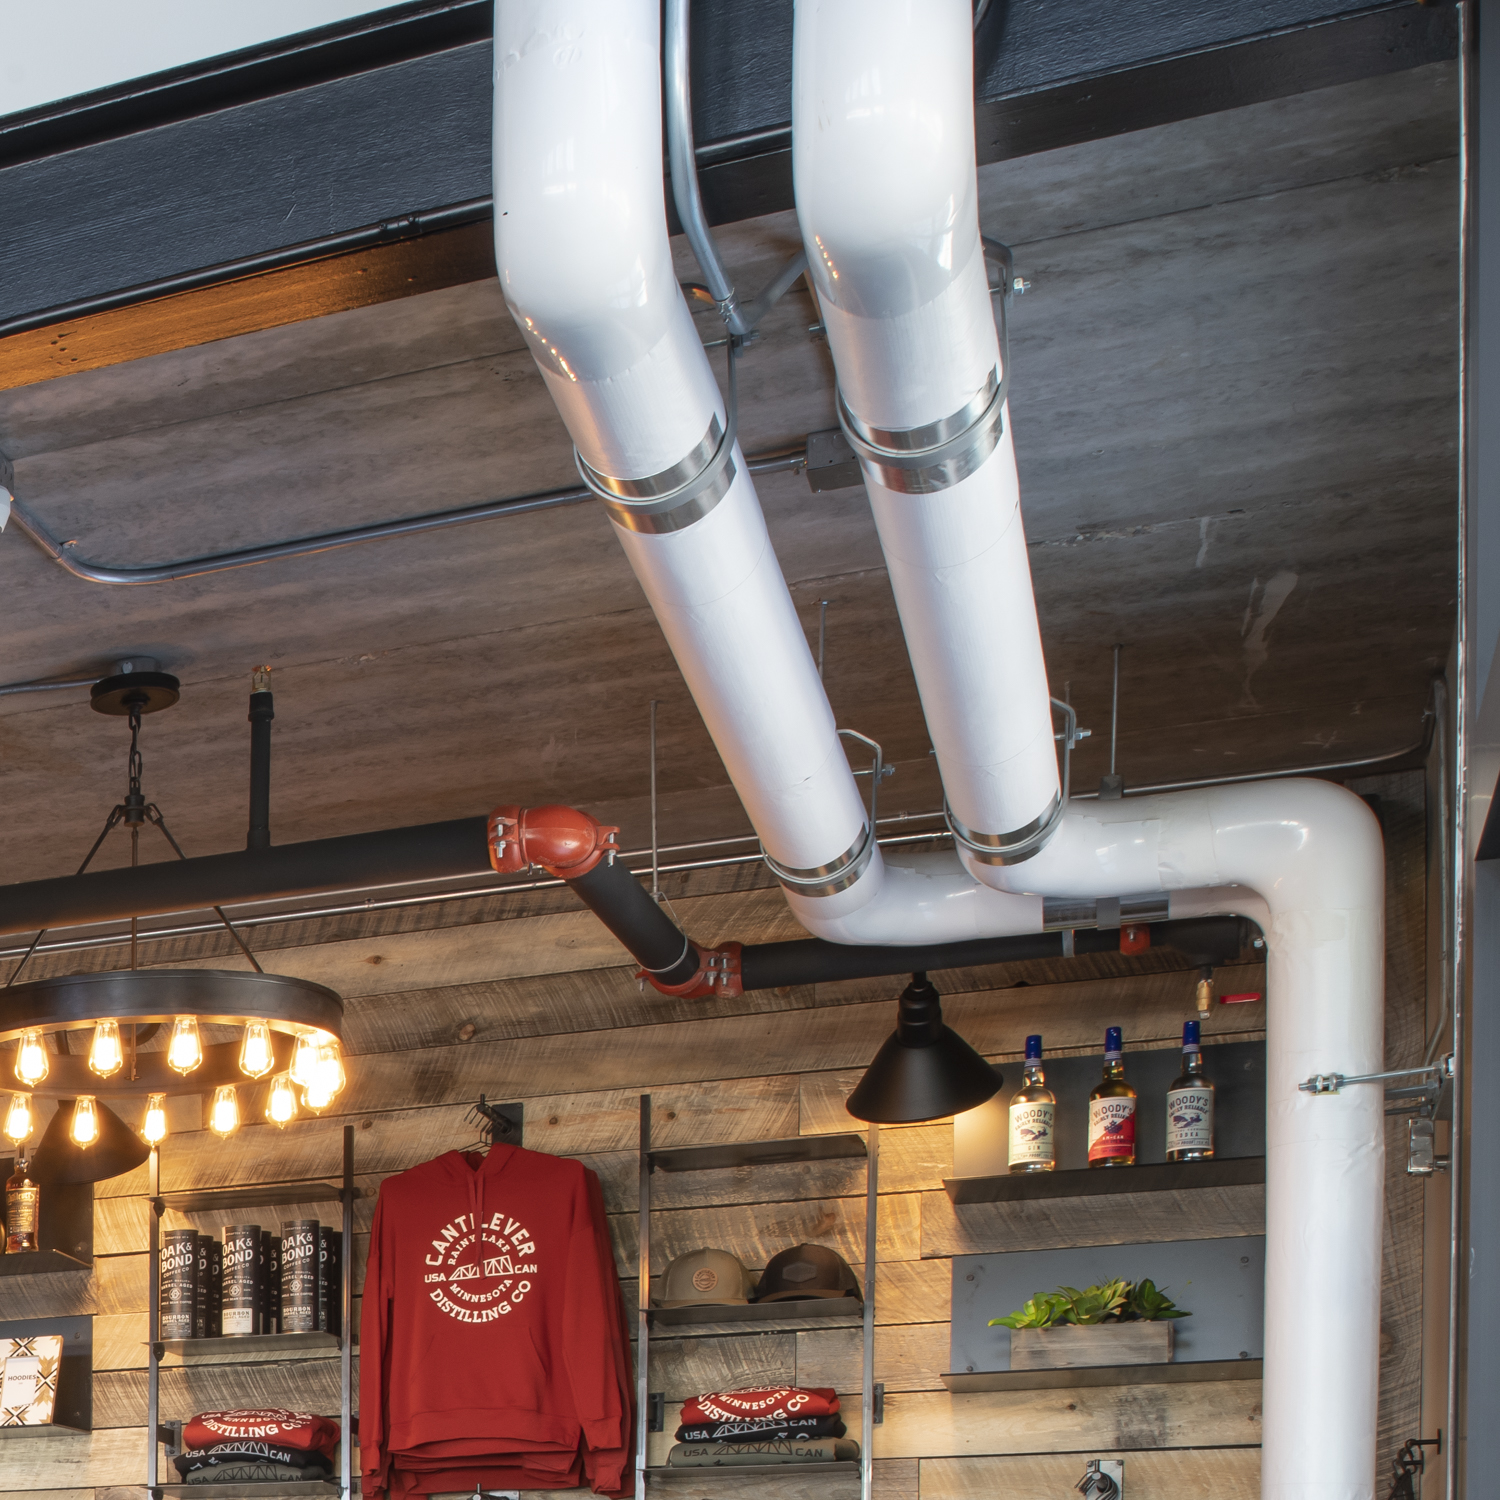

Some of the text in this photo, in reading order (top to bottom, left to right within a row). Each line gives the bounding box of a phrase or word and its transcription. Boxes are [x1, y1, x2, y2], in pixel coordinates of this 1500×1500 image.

[1093, 1104, 1133, 1118] WOODY'S
[1168, 1095, 1209, 1110] WOODY'S
[1015, 1109, 1053, 1123] WOODY'S
[222, 1249, 253, 1269] BOND
[281, 1244, 314, 1264] BOND
[447, 1233, 511, 1265] RAINY LAKE
[161, 1253, 193, 1273] BOND
[424, 1264, 538, 1283] USA CAN
[449, 1279, 513, 1303] MINNESOTA
[429, 1280, 531, 1323] DISTILLING CO
[697, 1394, 809, 1423] DISTILLING CO
[718, 1390, 789, 1410] MINNESOTA
[202, 1419, 279, 1438] DISTILLING
[684, 1418, 817, 1440] USA CAN
[185, 1450, 291, 1463] USA CAN
[683, 1447, 823, 1457] USA CAN
